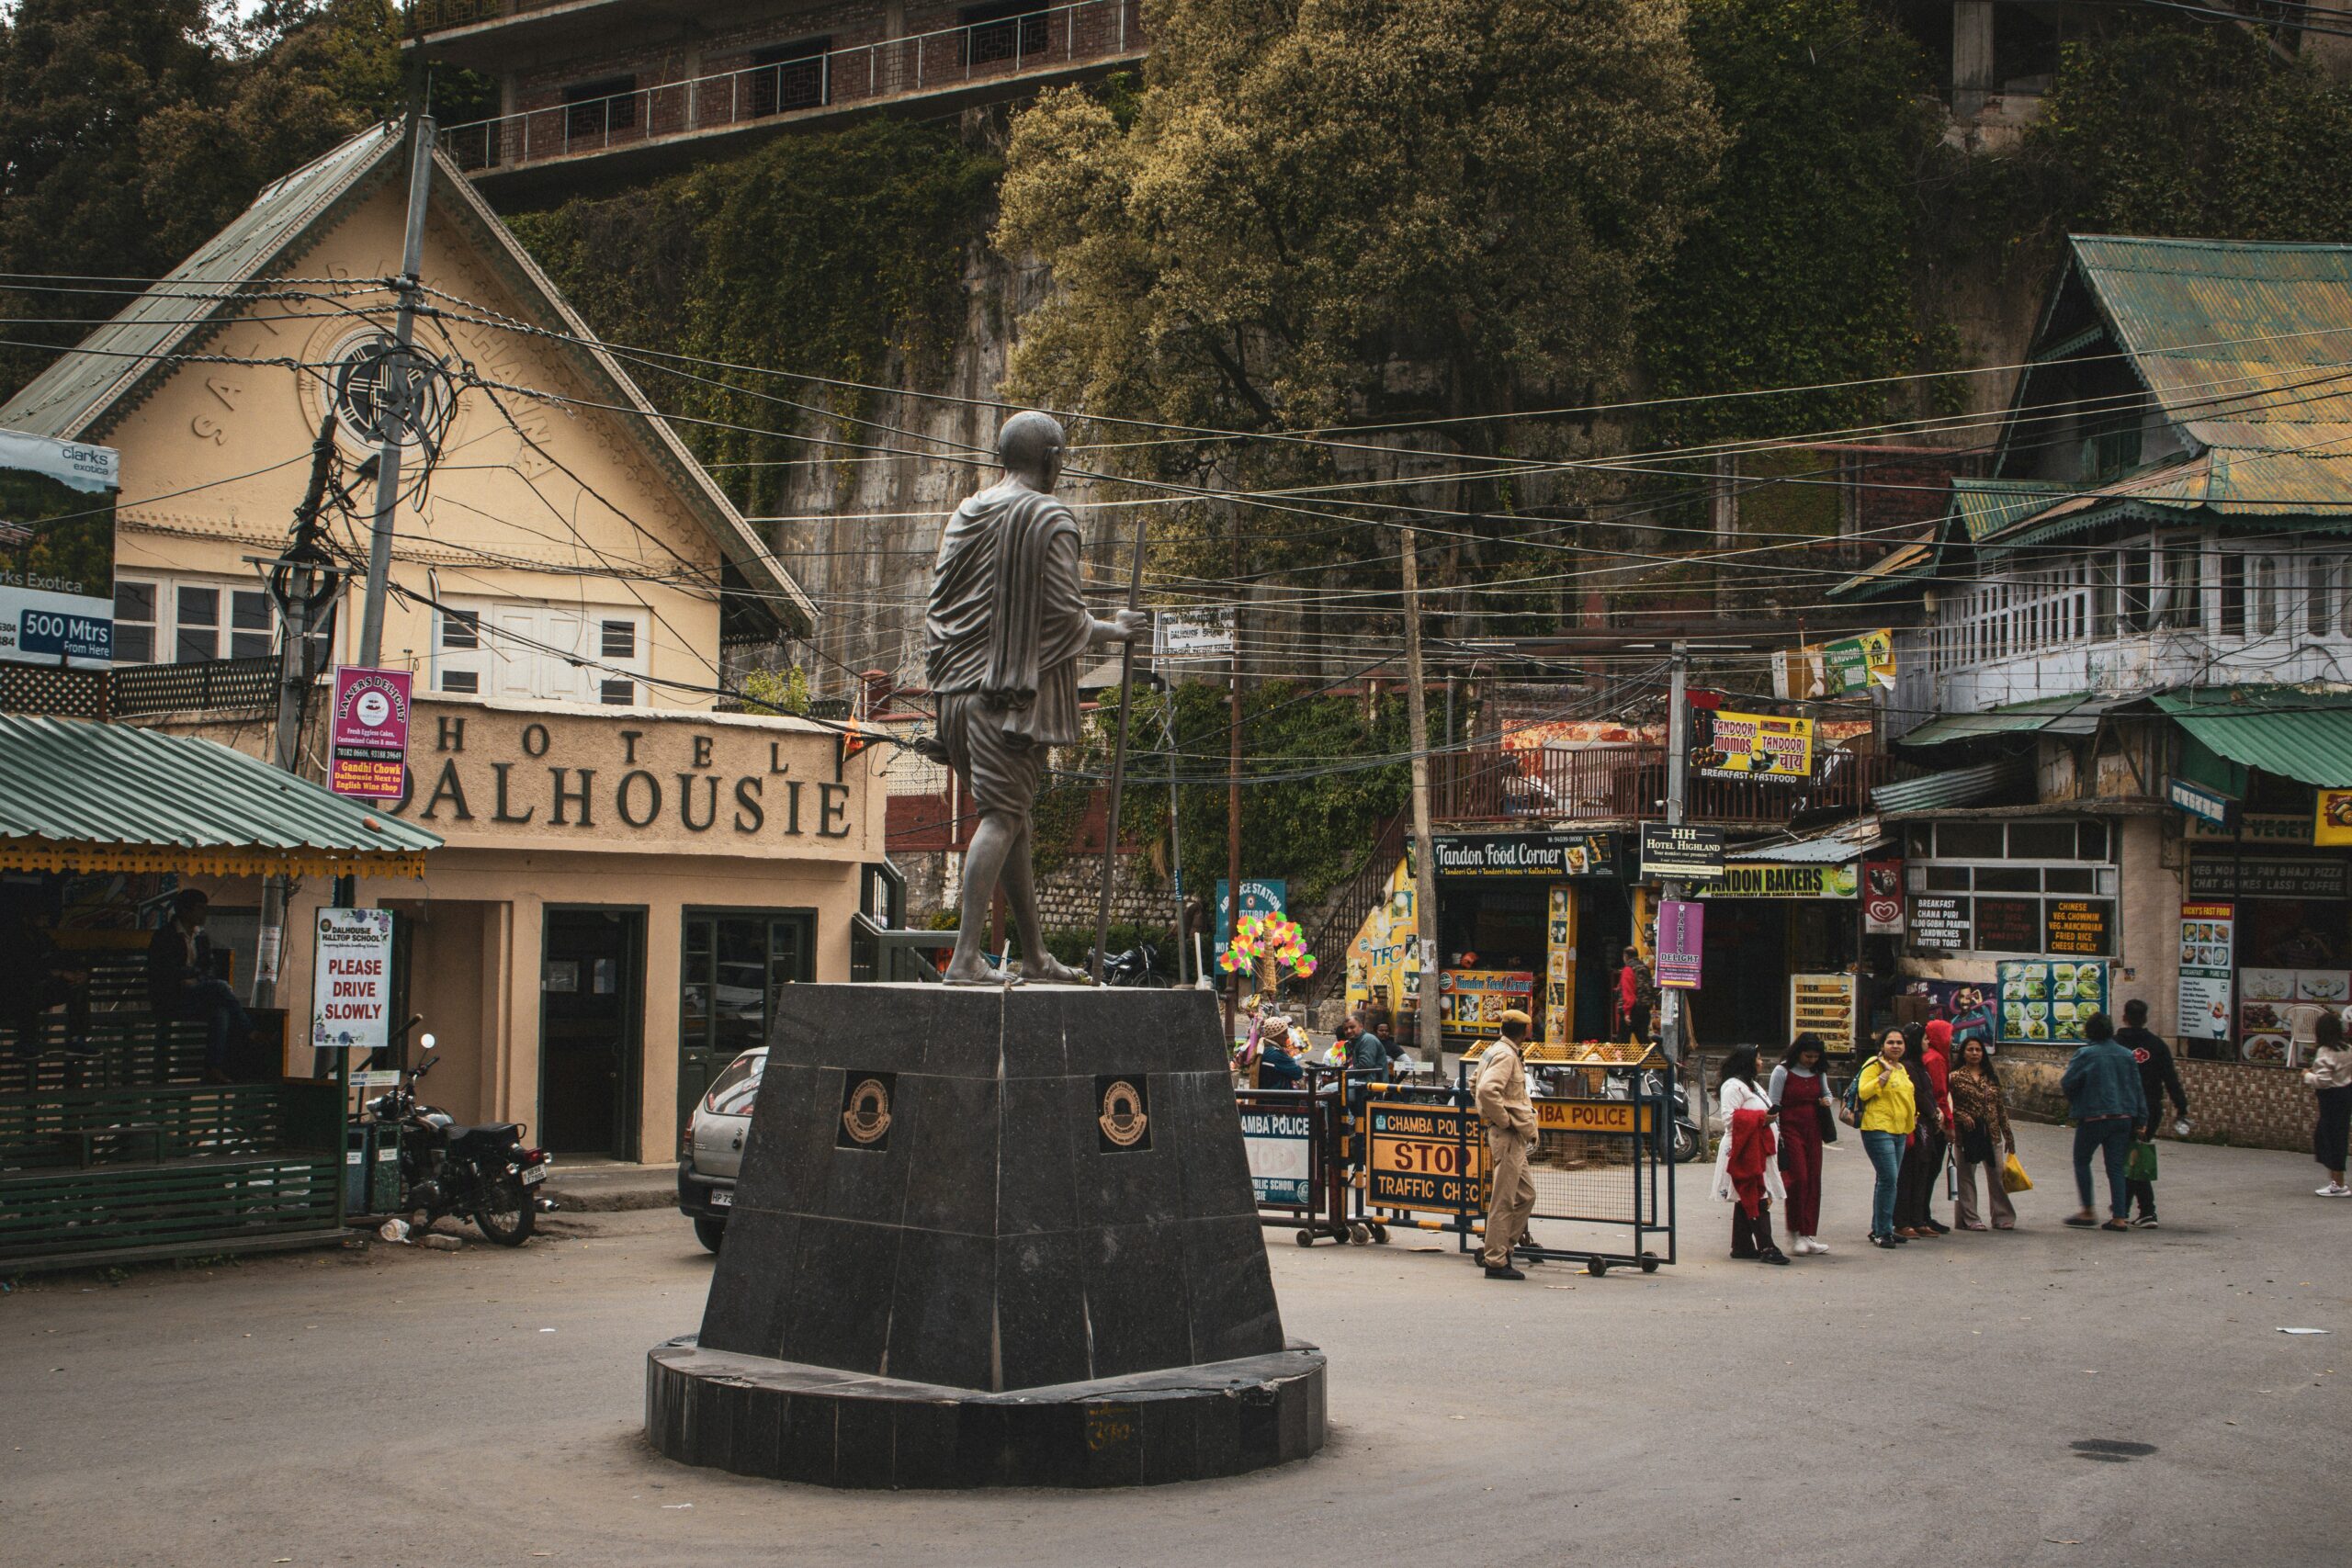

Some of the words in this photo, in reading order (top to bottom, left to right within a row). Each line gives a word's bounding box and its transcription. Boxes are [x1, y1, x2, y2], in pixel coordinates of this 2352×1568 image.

[62, 446, 108, 466] clarks
[74, 463, 108, 476] exotica
[28, 572, 83, 592] Exotica
[26, 614, 64, 637] 500
[69, 618, 108, 643] Mtrs
[64, 641, 86, 653] From
[89, 645, 110, 656] Here
[339, 676, 373, 719] BAKERS
[373, 676, 405, 723] DELIGHT
[361, 728, 379, 737] Eggless
[1713, 719, 1757, 737] TANDOORI
[436, 716, 789, 773] HOTEL
[1713, 736, 1752, 753] MOMOS
[1762, 736, 1806, 752] TANDOORI
[341, 761, 371, 773] Gandhi
[373, 763, 401, 774] Chowk
[1779, 753, 1805, 772] चाय
[334, 772, 372, 781] Dalhousie
[1701, 768, 1749, 780] BREAKFAST
[1754, 773, 1797, 784] FASTFOOD
[336, 781, 361, 790] English
[363, 782, 379, 790] Wine
[381, 784, 398, 794] Shop
[1670, 828, 1697, 840] HH
[1436, 844, 1484, 865] Tandon
[1485, 843, 1516, 865] Food
[1518, 842, 1562, 865] Corner
[1765, 868, 1824, 891] BAKERS
[2192, 865, 2211, 875] VEG
[2279, 867, 2311, 877] BHAJI
[2313, 867, 2343, 878] PIZZA
[2267, 880, 2296, 890] LASSI
[2301, 881, 2342, 891] COFFEE
[1251, 883, 1283, 912] STATION
[1917, 899, 1956, 908] BREAKFAST
[1917, 910, 1940, 919] CHANA
[1942, 910, 1959, 919] PURI
[2058, 902, 2087, 911] CHINESE
[2183, 907, 2202, 915] VICKY'S
[2204, 907, 2215, 916] FAST
[2216, 908, 2231, 916] FOOD
[1911, 919, 1926, 927] ALOO
[1927, 919, 1945, 928] GOBHI
[352, 934, 380, 942] SCHOOL
[1920, 929, 1960, 938] SANDWICHES
[2055, 931, 2075, 941] FRIED
[2077, 932, 2093, 942] RICE
[1917, 937, 1940, 946] BUTTER
[1942, 939, 1962, 947] TOAST
[2052, 942, 2075, 951] CHEESE
[2076, 942, 2097, 952] CHILLY
[1370, 944, 1403, 966] TFC
[1661, 953, 1699, 963] DELIGHT
[328, 959, 381, 976] PLEASE
[333, 981, 376, 998] DRIVE
[1455, 975, 1485, 990] Tandon
[1485, 976, 1504, 991] Food
[1506, 976, 1532, 992] Corner
[325, 1003, 382, 1020] SLOWLY
[1572, 1107, 1627, 1125] POLICE
[1272, 1117, 1309, 1136] POLICE
[1387, 1115, 1433, 1134] CHAMBA
[1438, 1119, 1478, 1137] POLCE
[1395, 1143, 1472, 1175] STOP
[1270, 1179, 1295, 1191] SCHOOL
[1378, 1175, 1434, 1198] TRAFFIC
[712, 1193, 722, 1202] HP
